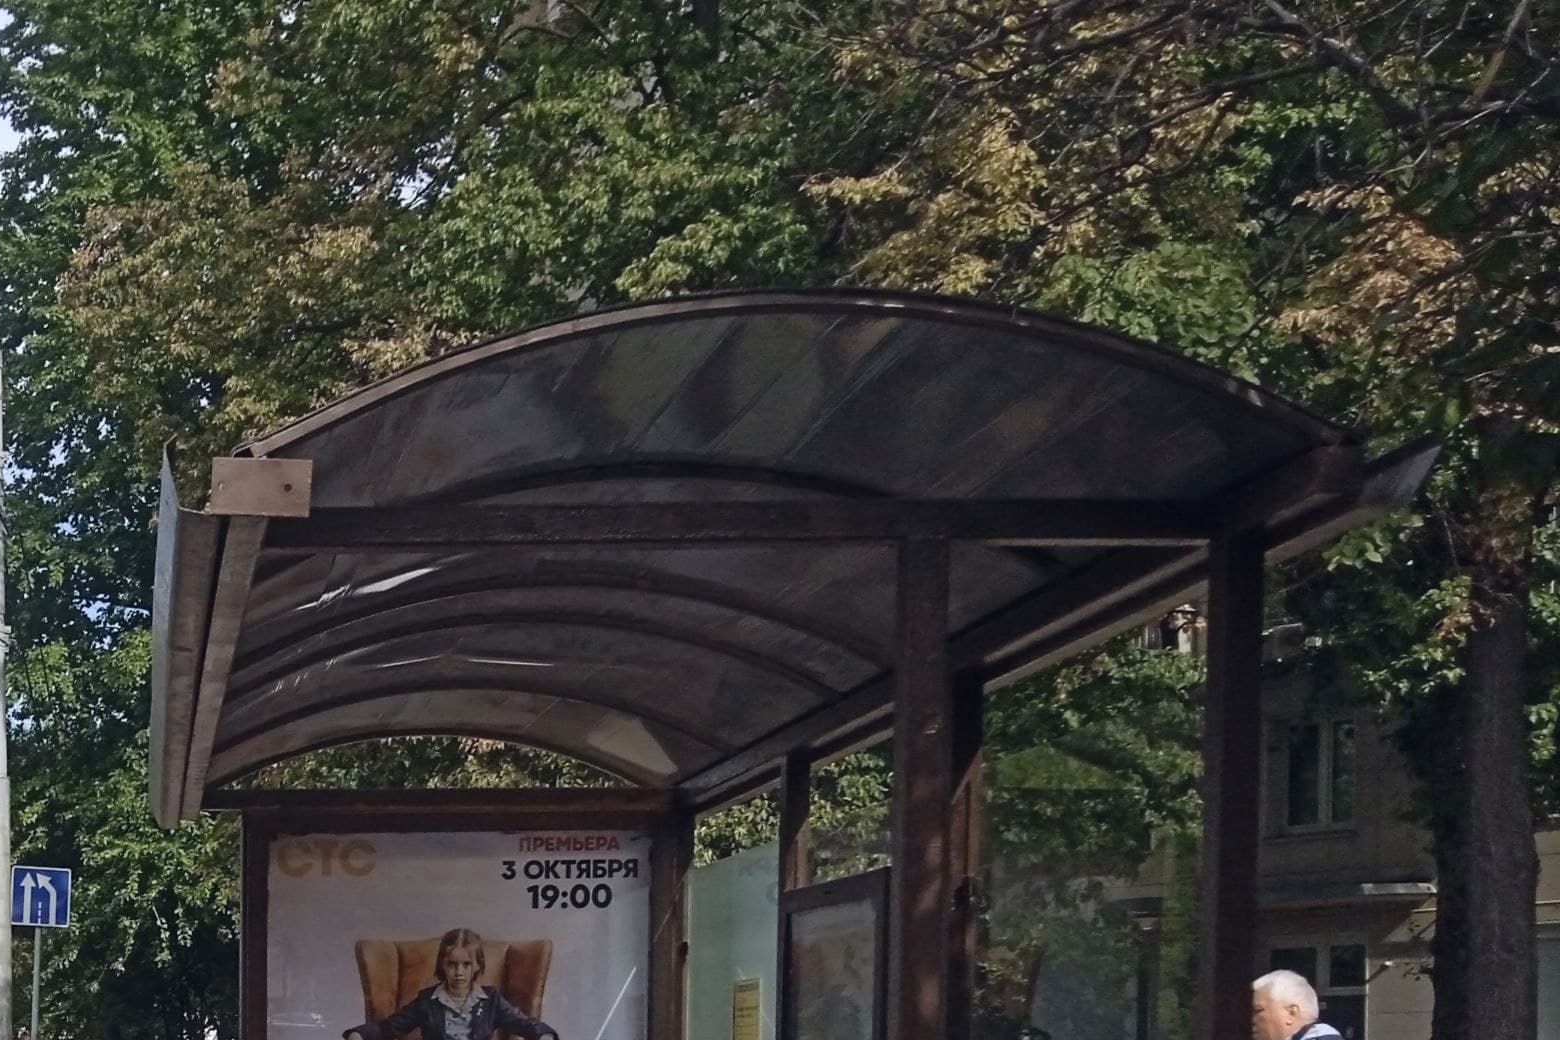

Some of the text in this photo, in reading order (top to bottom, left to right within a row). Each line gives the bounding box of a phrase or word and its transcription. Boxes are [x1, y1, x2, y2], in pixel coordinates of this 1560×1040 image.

[518, 836, 620, 852] ПРЕМЬЕРА
[278, 839, 377, 877] СТС
[501, 858, 639, 880] 3 ОКТЯБРЯ
[527, 883, 613, 909] 19:00
